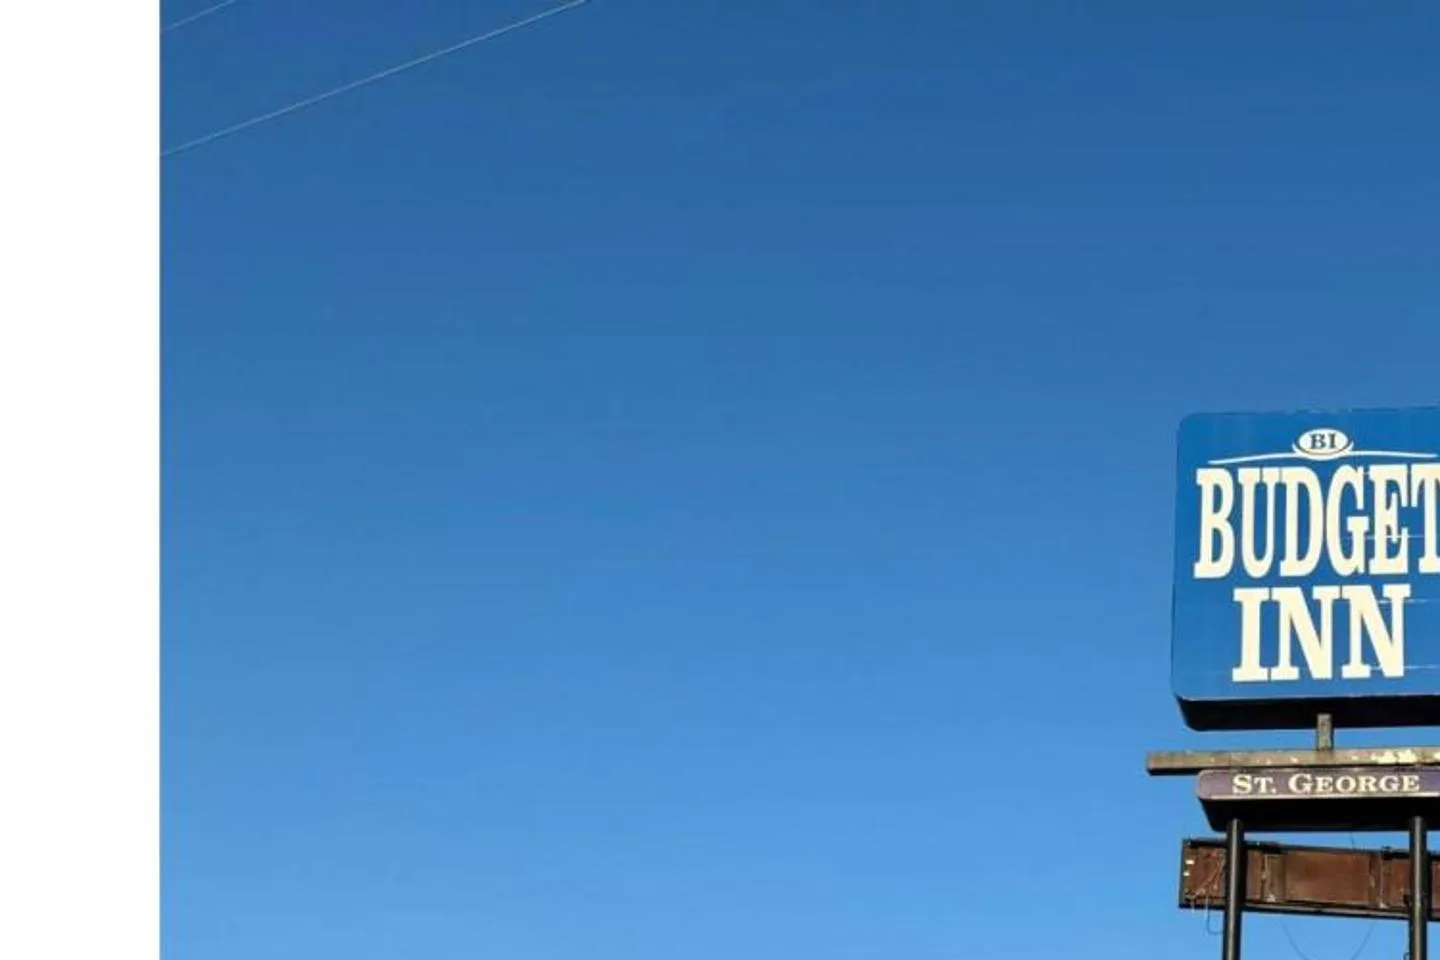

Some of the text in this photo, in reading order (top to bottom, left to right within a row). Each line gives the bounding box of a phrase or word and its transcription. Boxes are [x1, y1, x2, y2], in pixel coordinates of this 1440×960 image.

[1310, 433, 1336, 449] BI
[1232, 584, 1411, 682] INN
[1289, 774, 1420, 793] GEORGE
